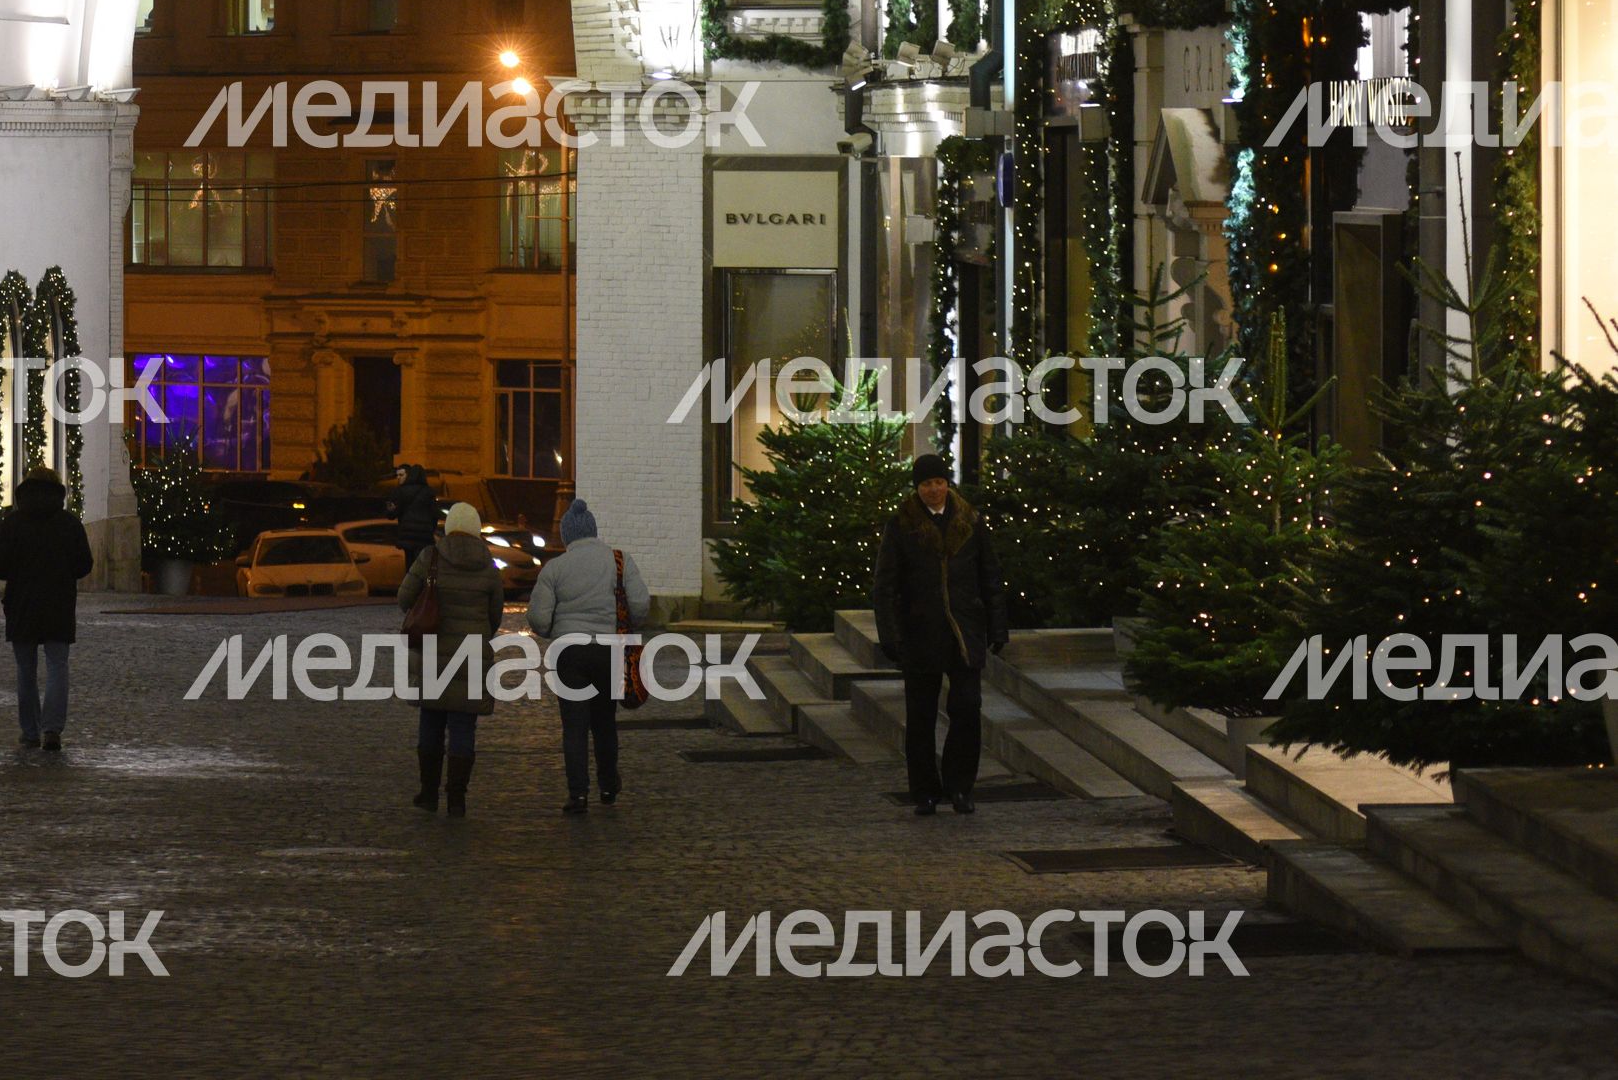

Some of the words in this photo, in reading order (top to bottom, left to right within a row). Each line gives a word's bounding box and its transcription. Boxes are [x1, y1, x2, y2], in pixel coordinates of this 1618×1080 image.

[1183, 43, 1228, 93] GRAF
[1330, 80, 1363, 127] HARRY
[725, 212, 827, 226] BVLGARI
